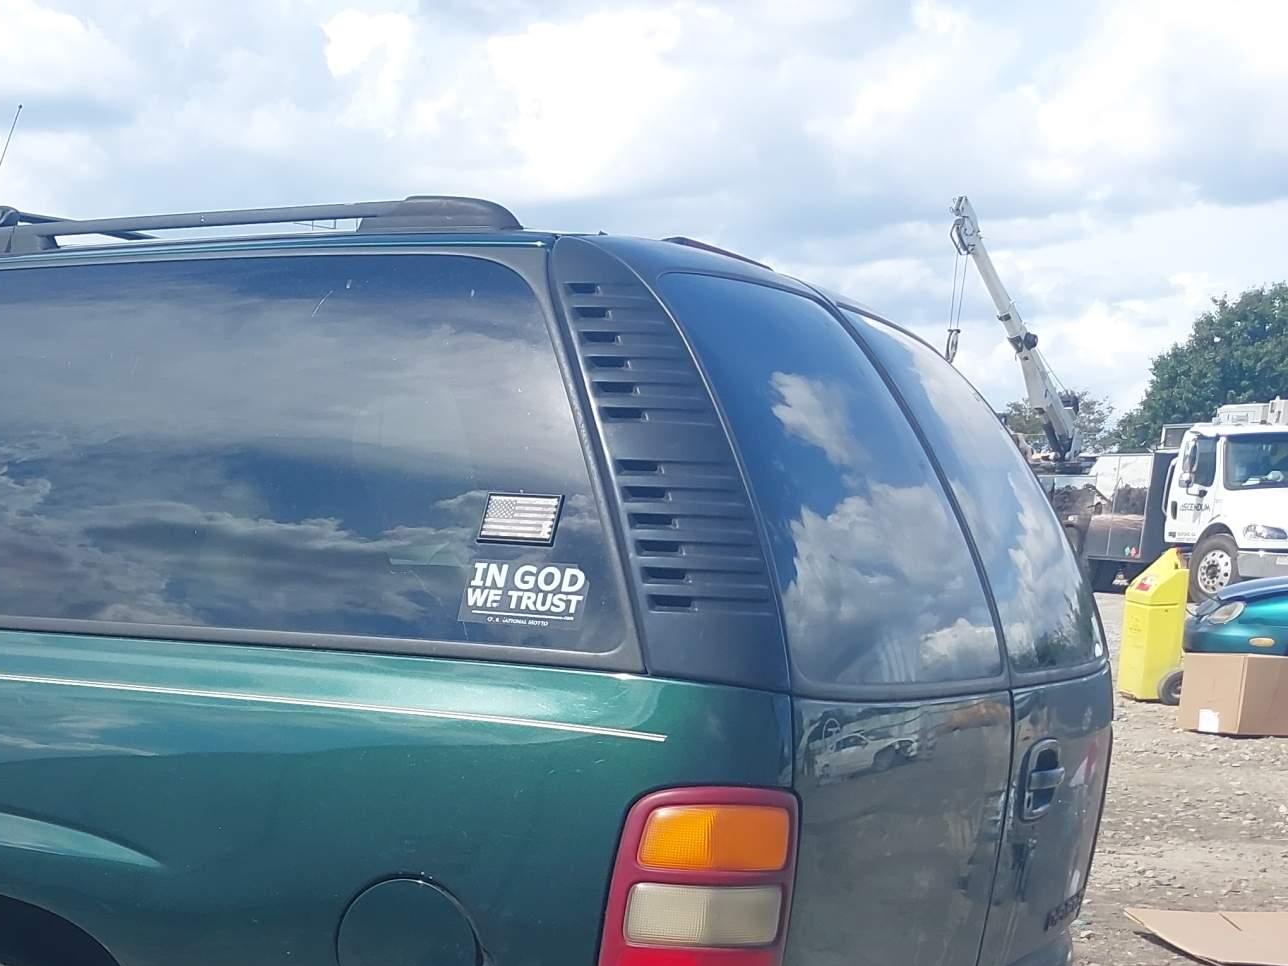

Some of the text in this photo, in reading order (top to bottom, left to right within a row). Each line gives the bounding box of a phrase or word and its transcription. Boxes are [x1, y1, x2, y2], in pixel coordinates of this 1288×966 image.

[470, 562, 585, 593] IN GOD
[467, 588, 584, 614] WE TRUST
